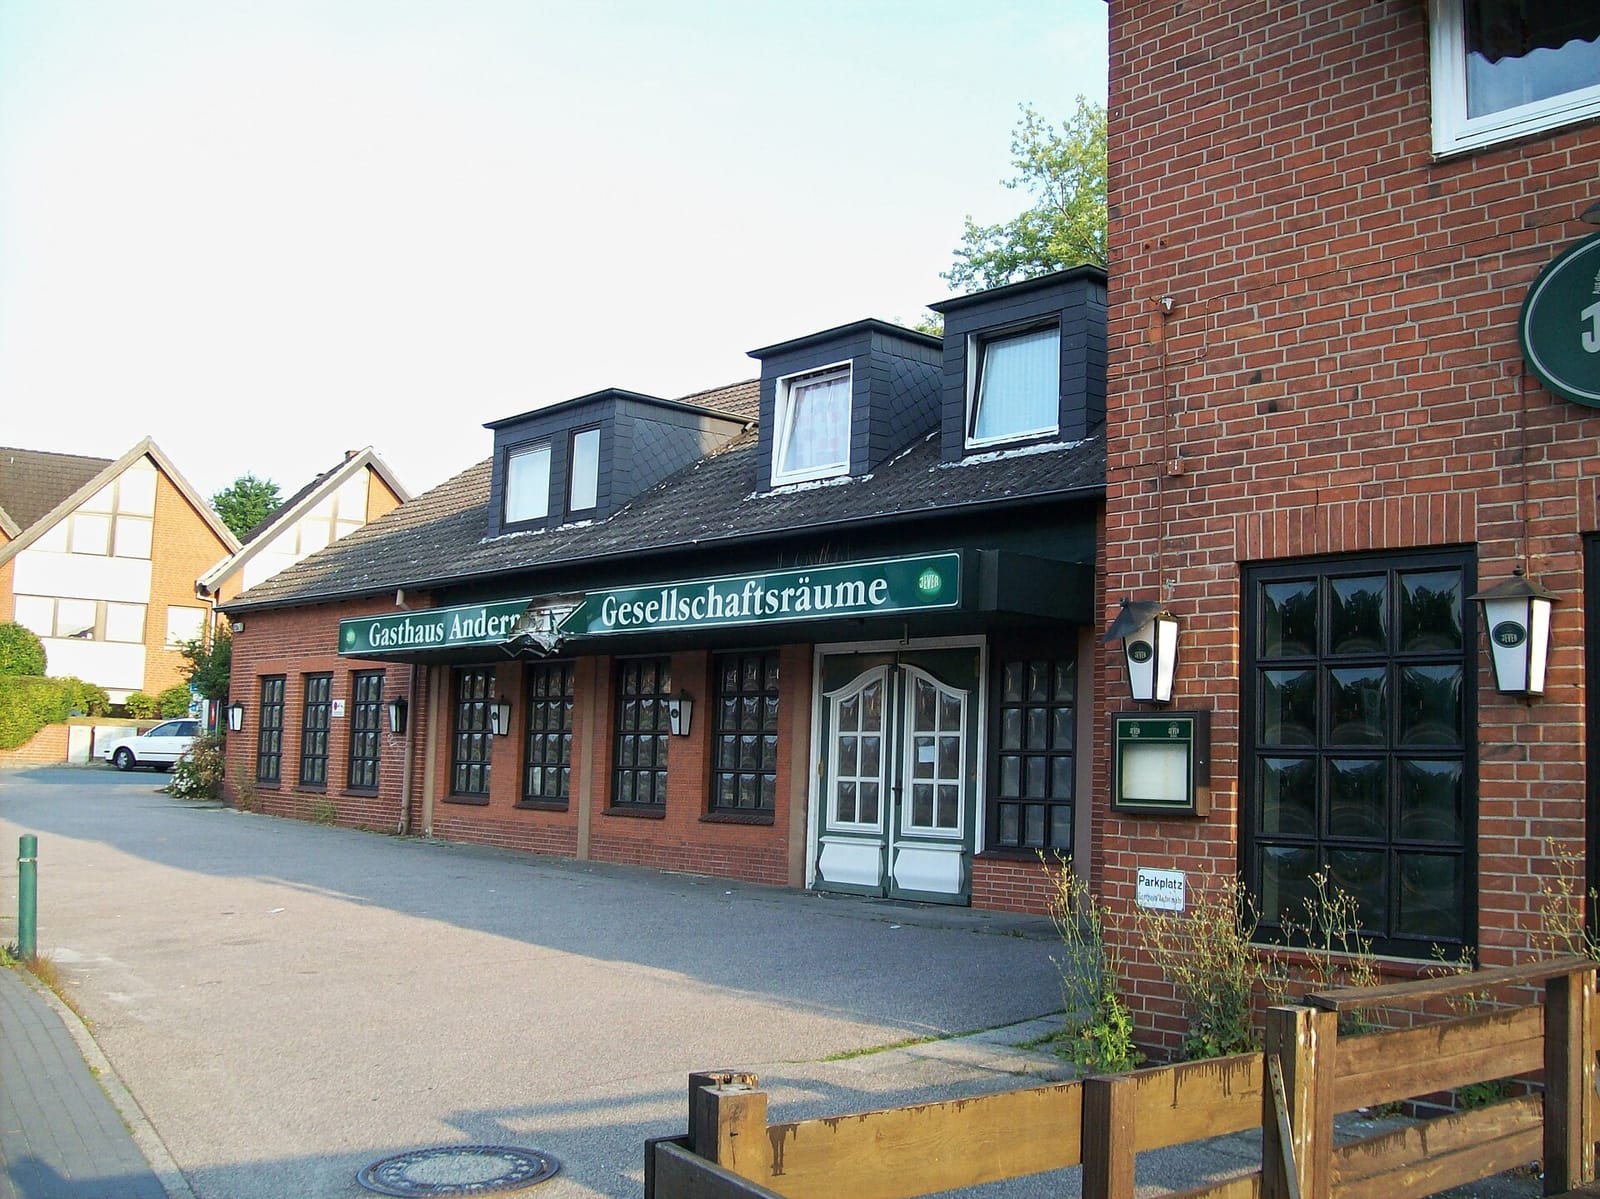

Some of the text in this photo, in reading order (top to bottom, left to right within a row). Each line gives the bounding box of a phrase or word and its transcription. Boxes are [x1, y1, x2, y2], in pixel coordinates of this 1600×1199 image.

[601, 577, 888, 627] Gesellschaftsräume
[369, 617, 445, 648] Gasthaus
[1138, 875, 1183, 891] Parkplatz
